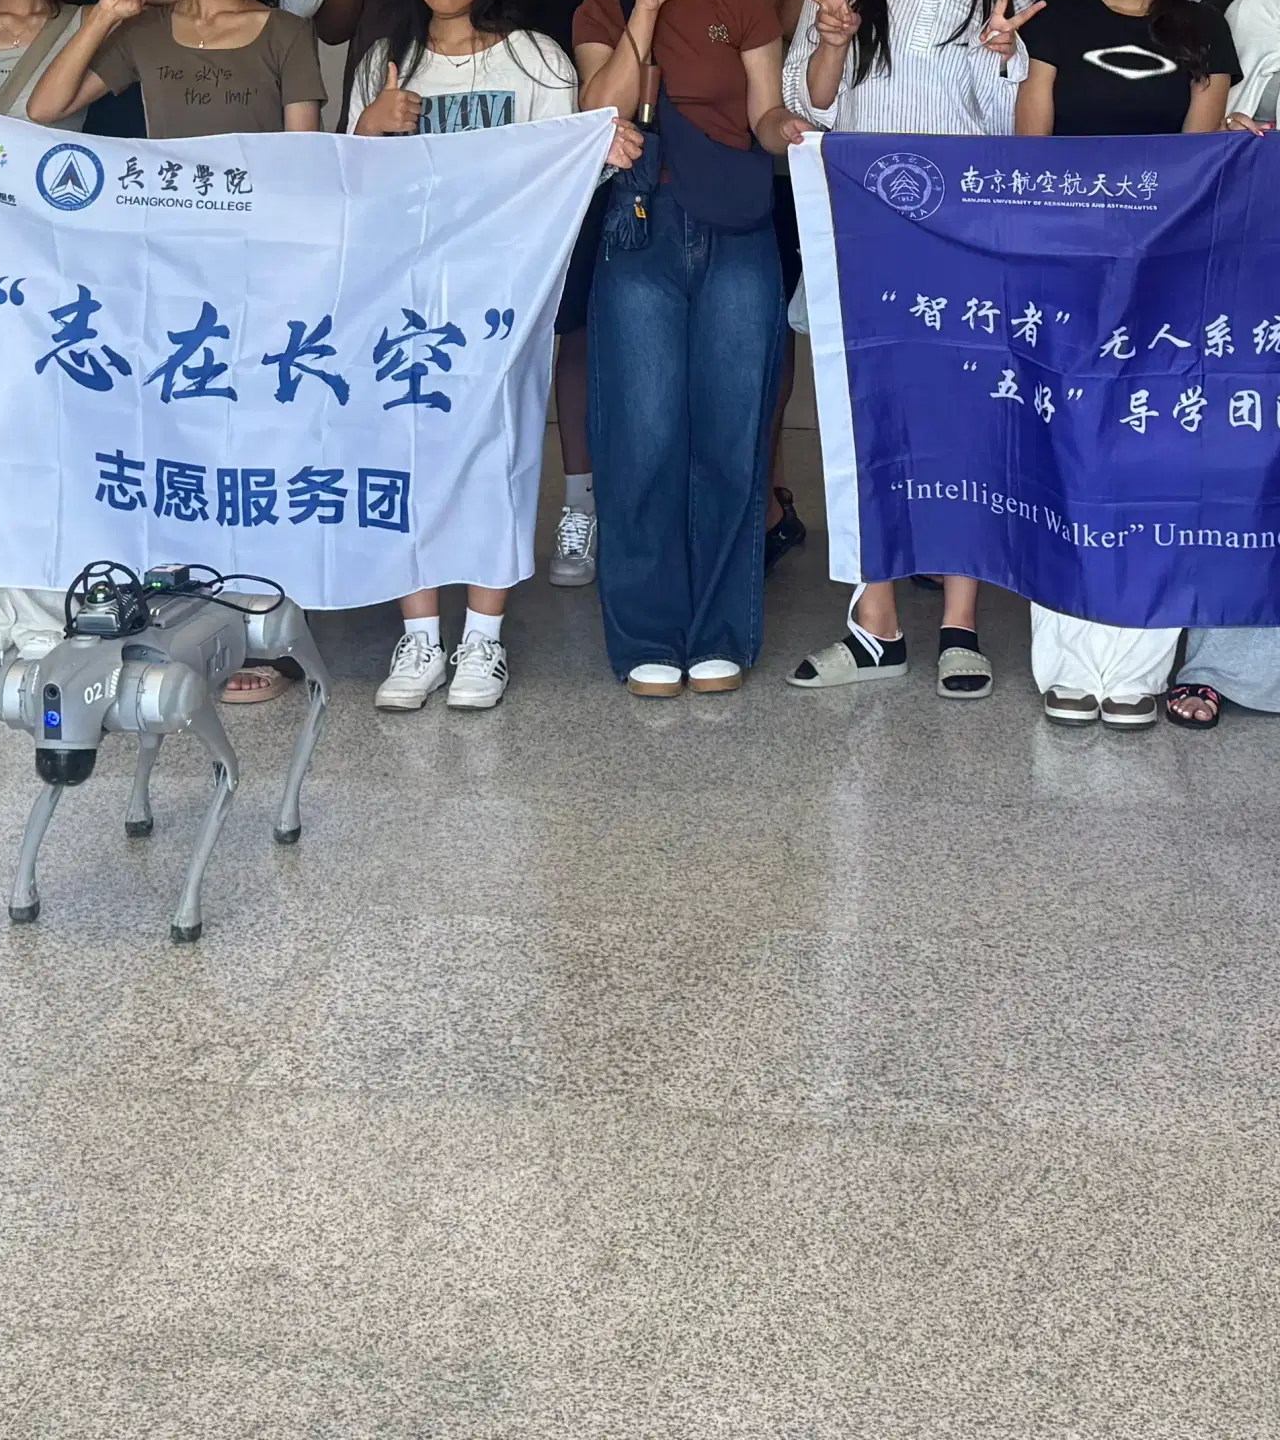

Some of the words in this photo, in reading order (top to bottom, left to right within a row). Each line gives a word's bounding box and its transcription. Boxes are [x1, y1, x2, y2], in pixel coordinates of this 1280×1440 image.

[156, 65, 184, 80] The
[195, 65, 232, 88] sky's
[184, 87, 212, 106] the
[414, 93, 514, 135] RVANA
[116, 195, 194, 210] CHANGKONG
[196, 198, 253, 212] COLLEGE
[95, 450, 411, 534] 志愿服务团
[84, 682, 104, 705] 02
